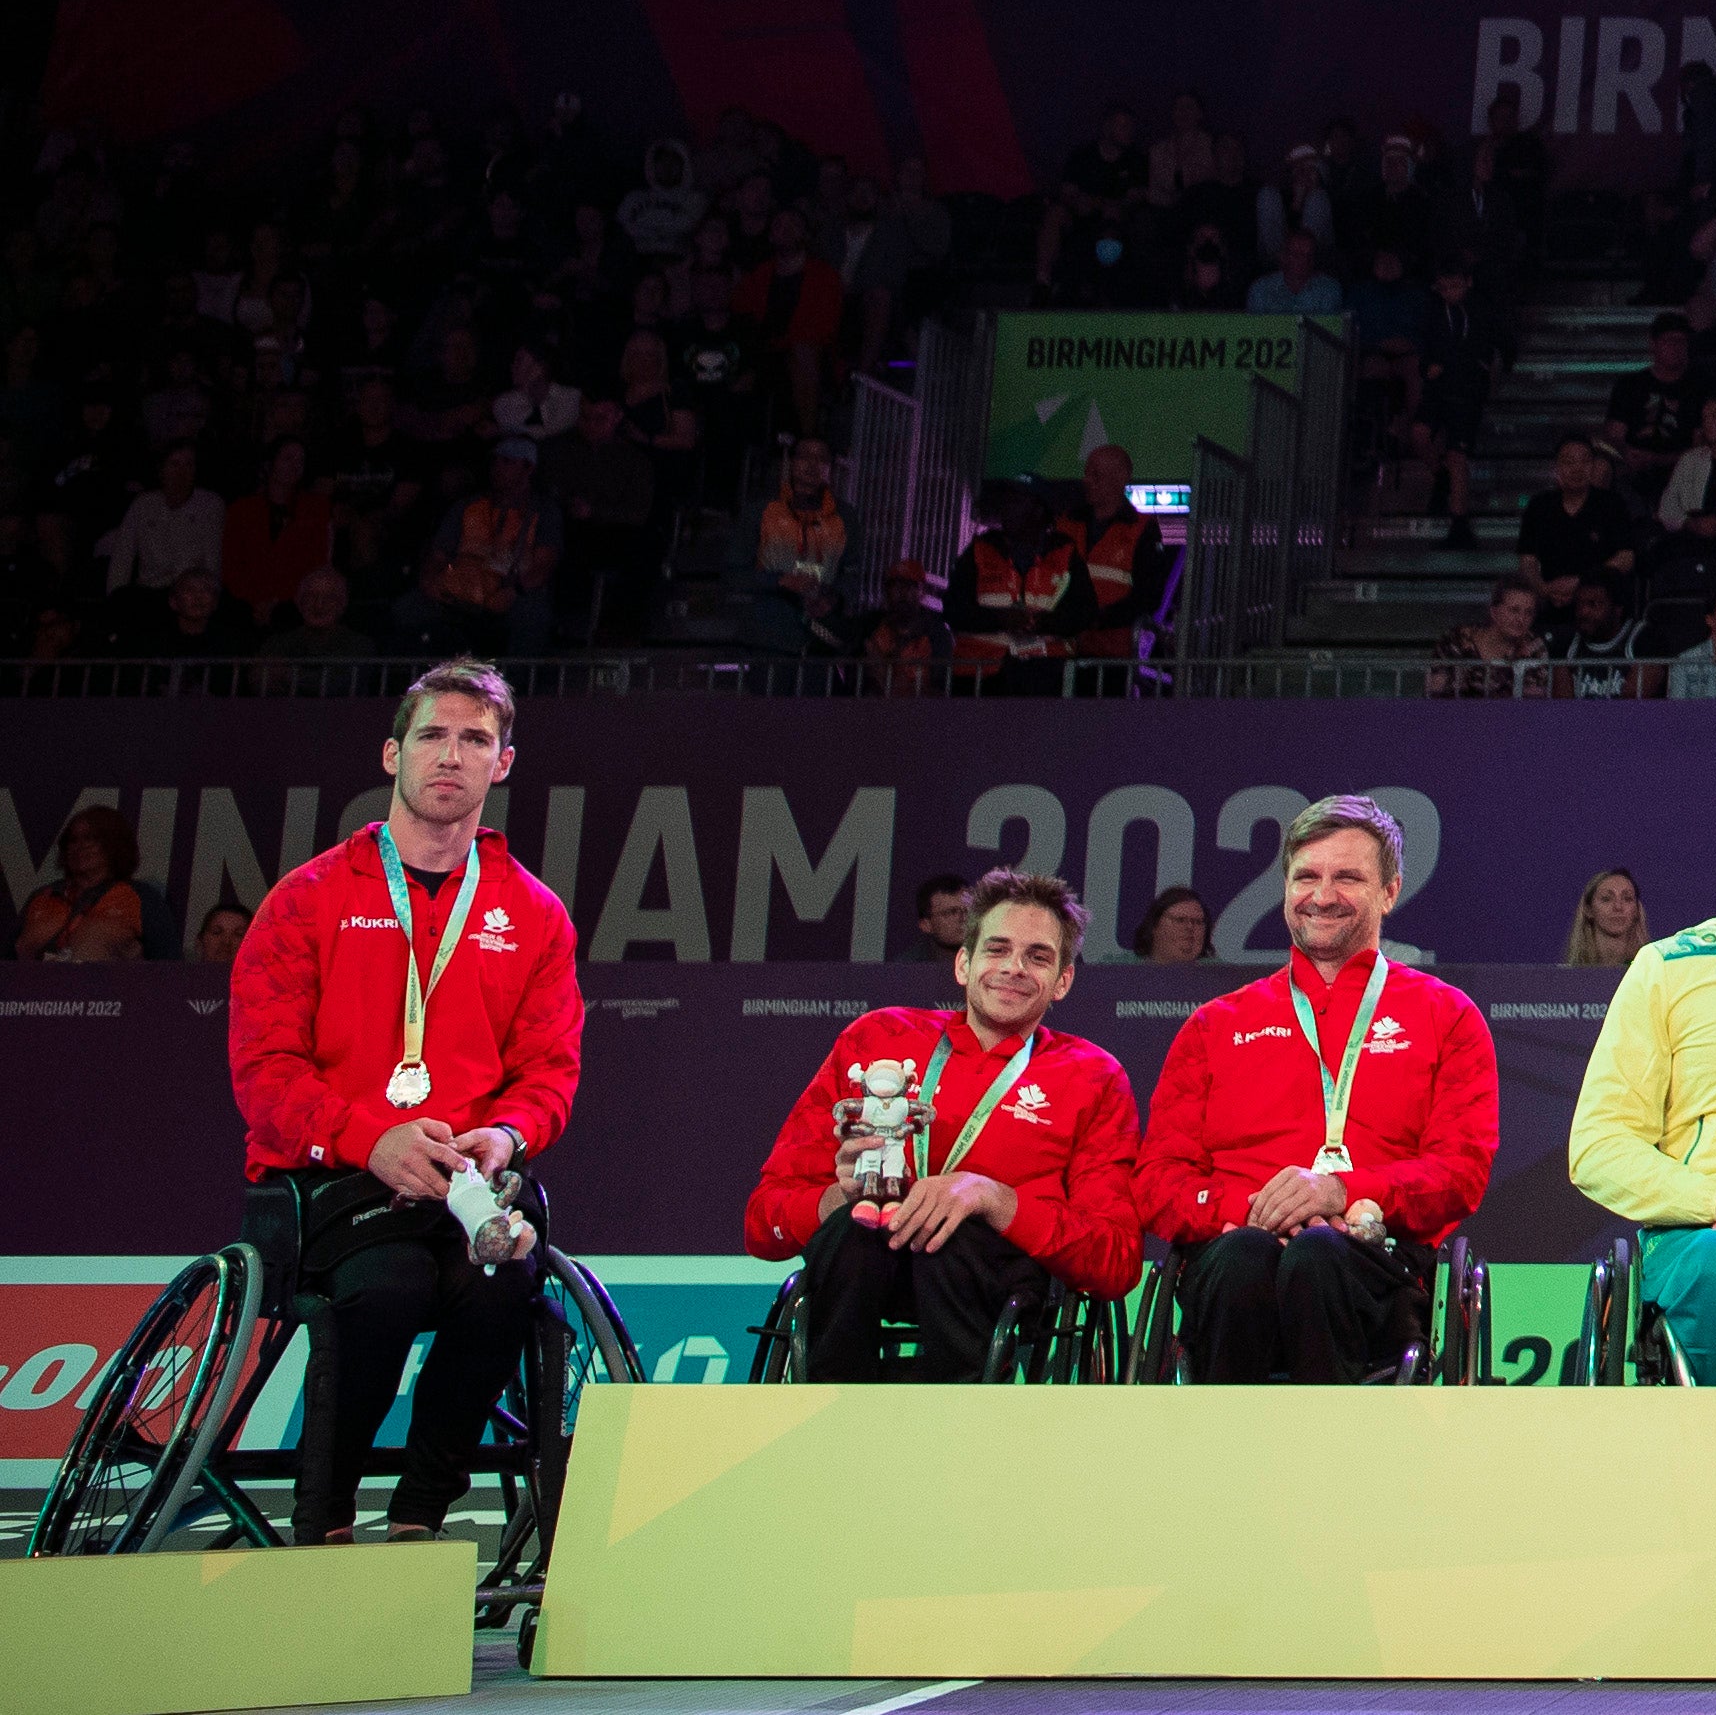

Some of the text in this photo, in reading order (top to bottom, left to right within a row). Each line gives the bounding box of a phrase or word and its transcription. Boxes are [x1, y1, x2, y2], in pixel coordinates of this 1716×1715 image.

[1027, 338, 1293, 369] BIRMINGHAM 202
[351, 915, 399, 929] KUKRI
[0, 1001, 122, 1017] BIRMINGHAM 2022
[742, 1000, 830, 1016] BIRMINGHAM
[1490, 1002, 1608, 1019] BIRMINGHAM 202
